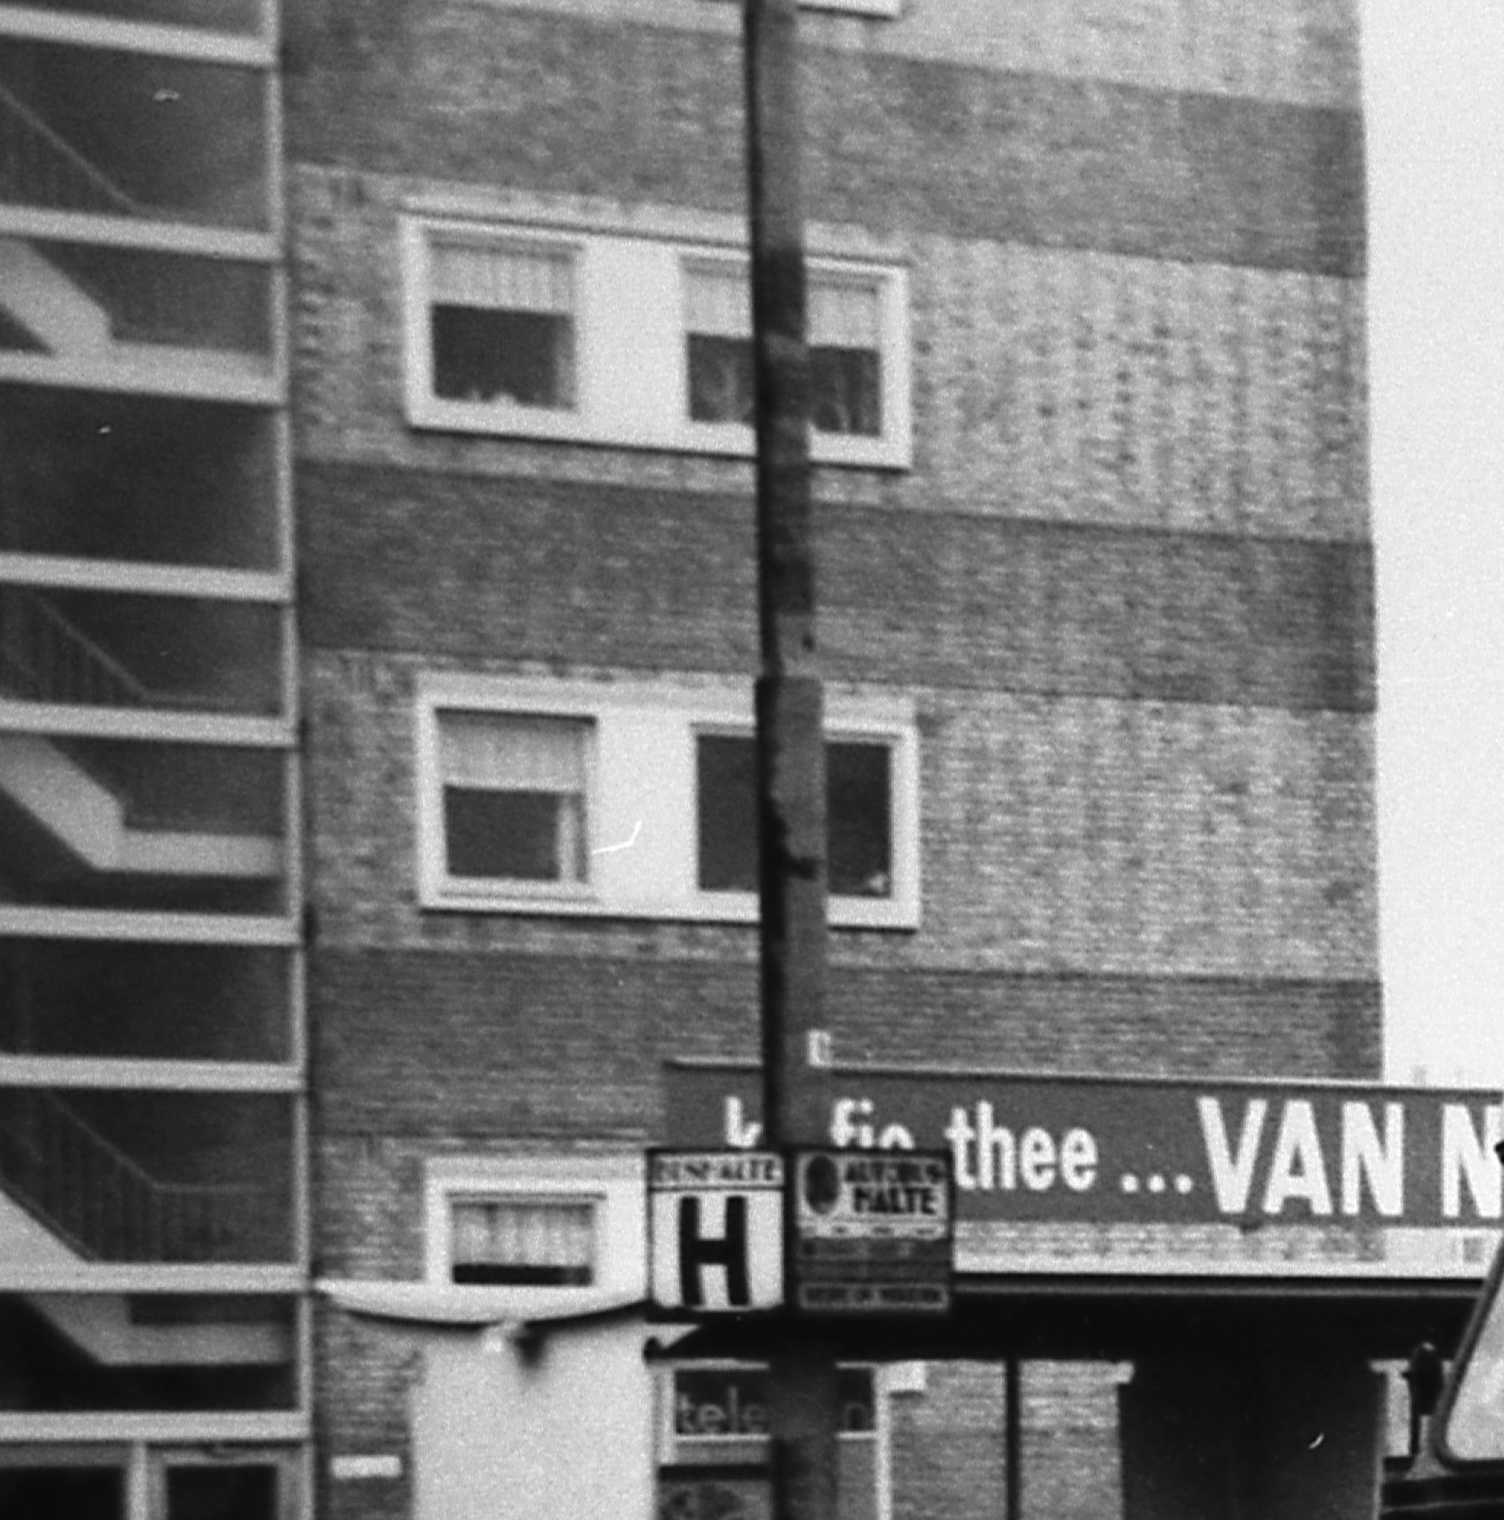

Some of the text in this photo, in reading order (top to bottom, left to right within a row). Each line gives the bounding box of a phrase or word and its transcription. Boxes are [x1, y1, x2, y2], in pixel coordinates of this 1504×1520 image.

[944, 1099, 1099, 1191] thee
[1195, 1096, 1404, 1217] VAN
[678, 1195, 749, 1307] H
